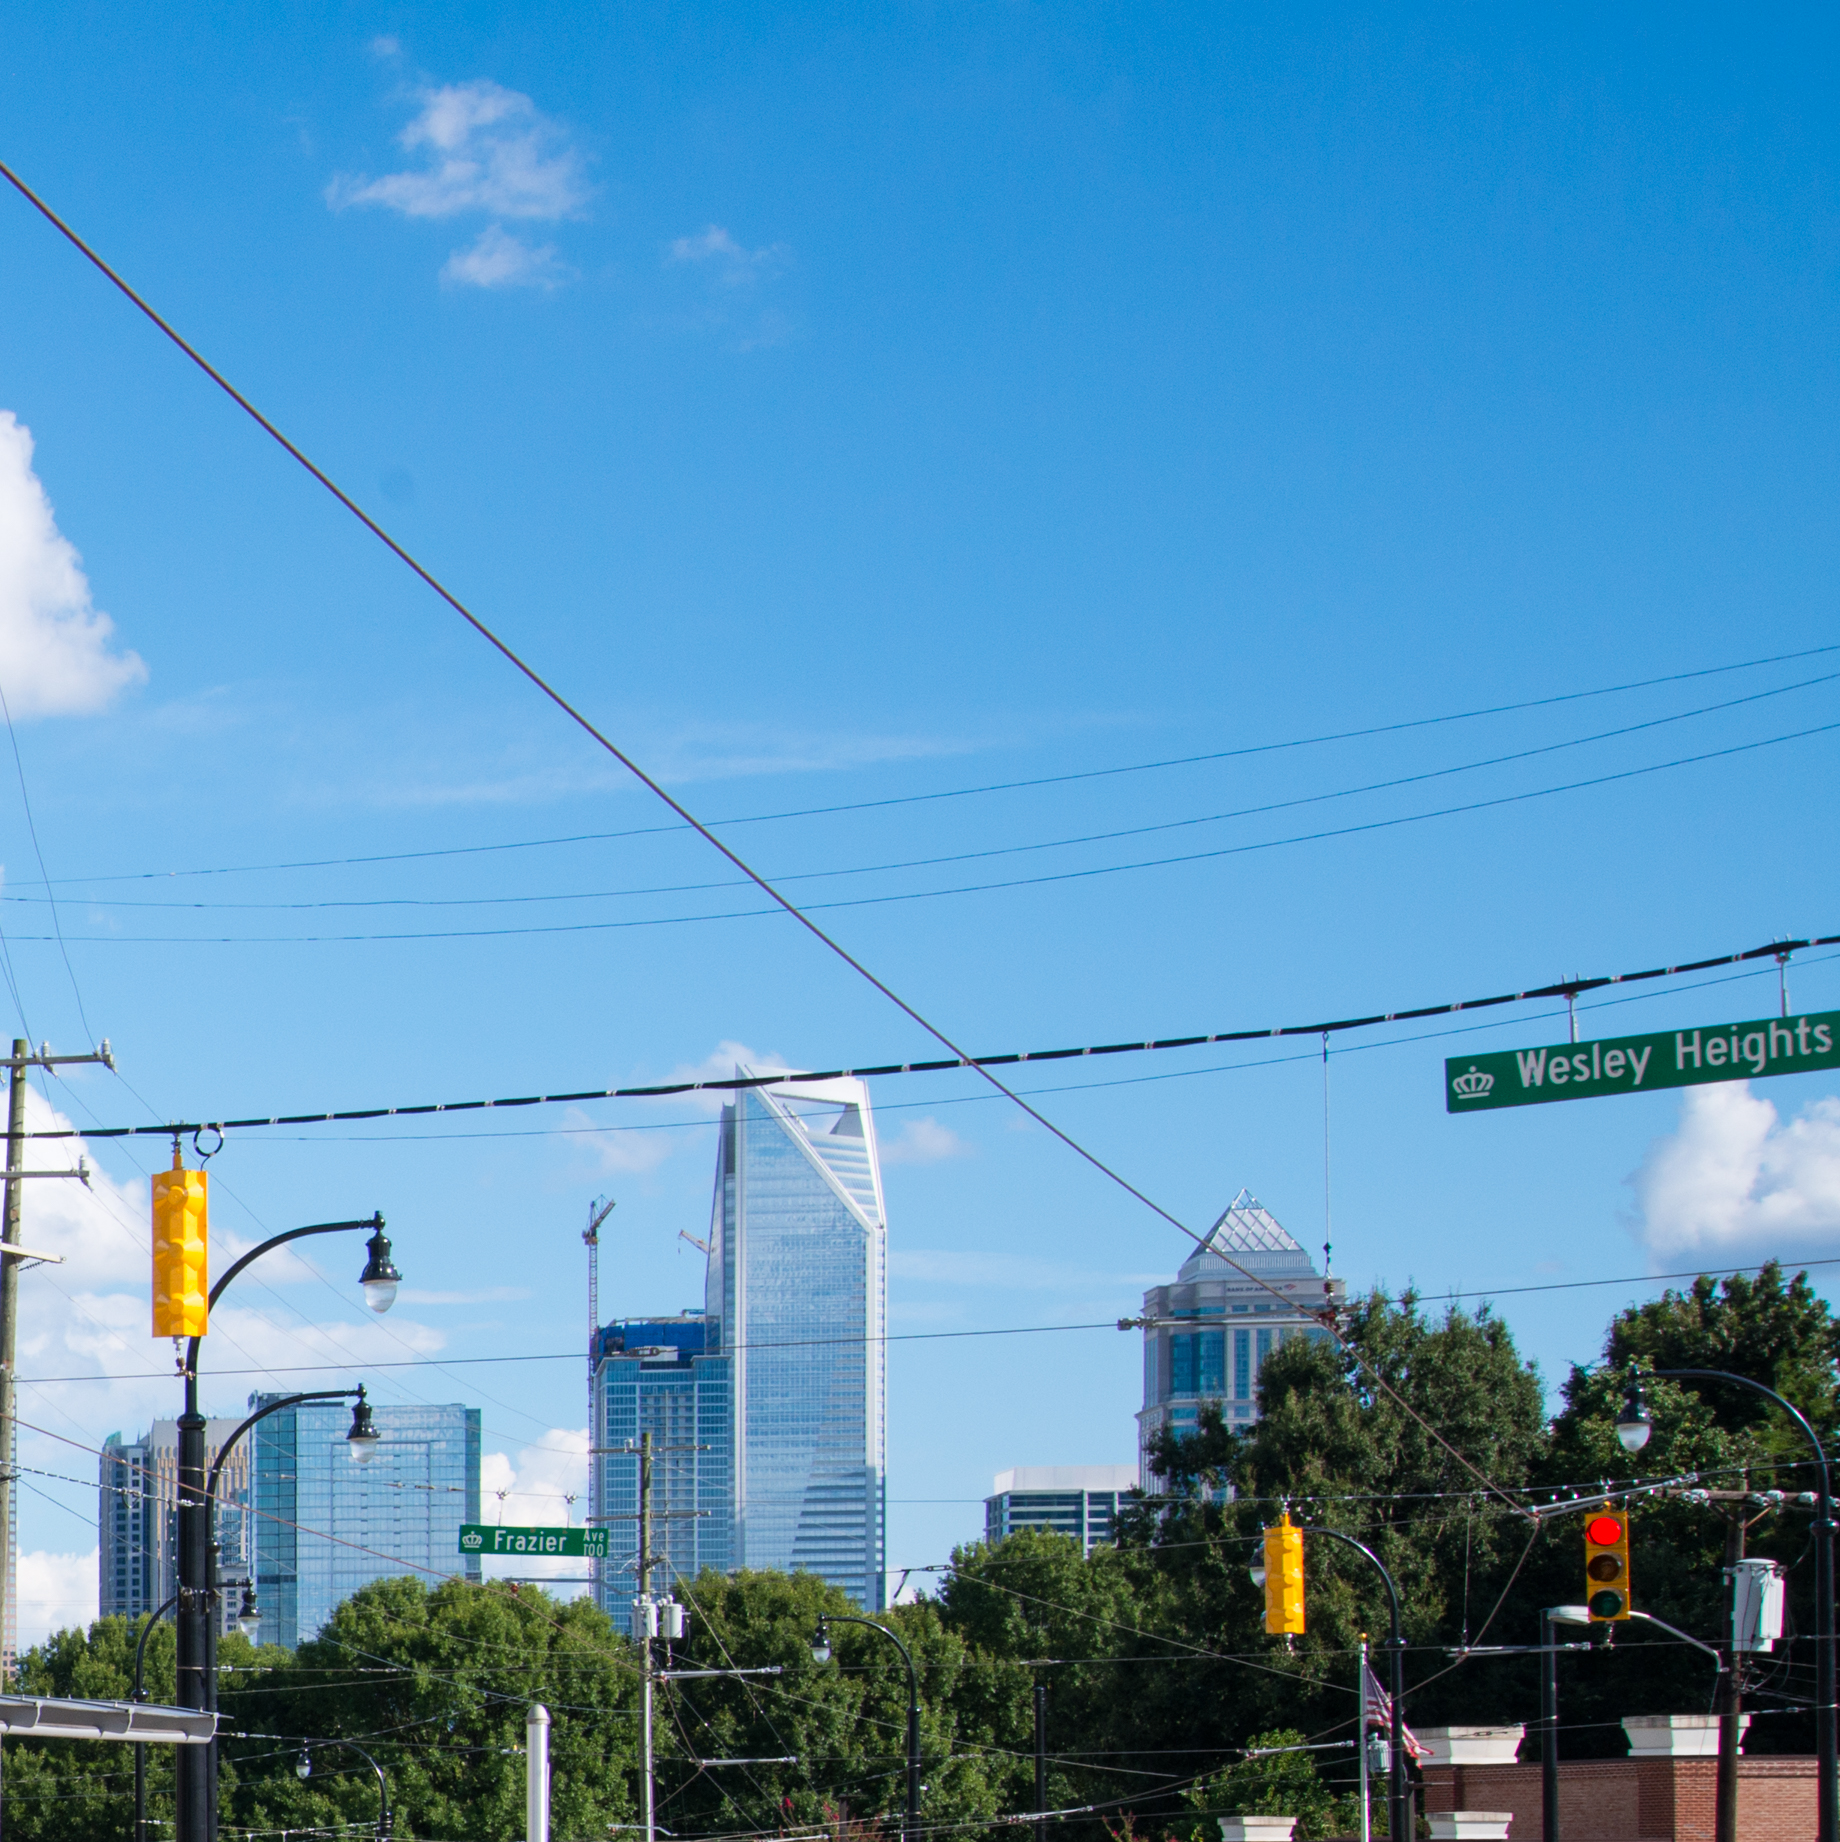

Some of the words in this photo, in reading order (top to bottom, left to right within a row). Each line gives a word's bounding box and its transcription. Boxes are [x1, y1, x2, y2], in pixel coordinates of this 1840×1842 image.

[1516, 1042, 1652, 1087] Wesley
[1676, 1017, 1831, 1074] Heights
[493, 1530, 567, 1552] Frazier
[583, 1529, 604, 1542] Ave
